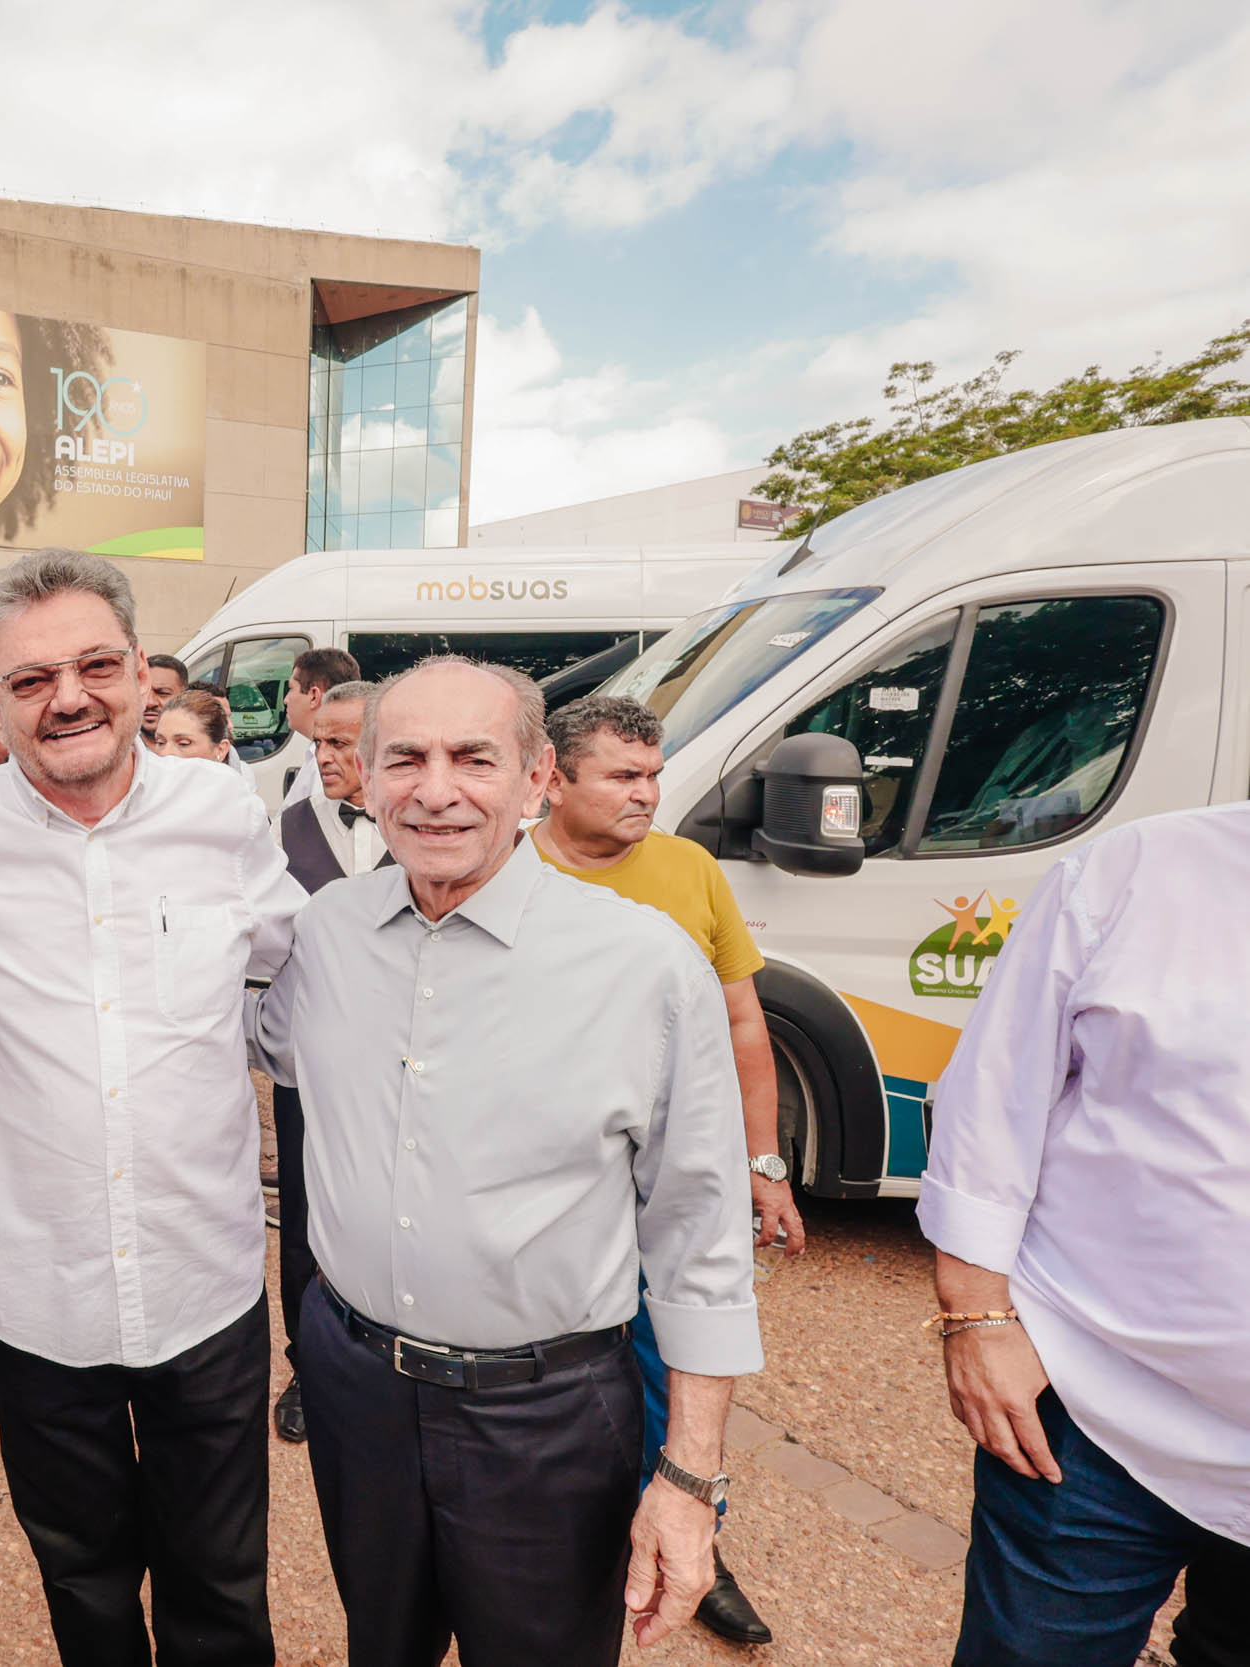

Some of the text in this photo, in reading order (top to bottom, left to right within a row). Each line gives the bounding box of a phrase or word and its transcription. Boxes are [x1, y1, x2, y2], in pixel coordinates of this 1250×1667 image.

[54, 435, 135, 467] ALEPI
[54, 464, 190, 489] ASSEMBLEIA LEGISLATIVA
[54, 479, 74, 492] DO
[76, 481, 121, 497] ESTADO
[124, 487, 142, 498] DO
[416, 574, 569, 601] mobsuas
